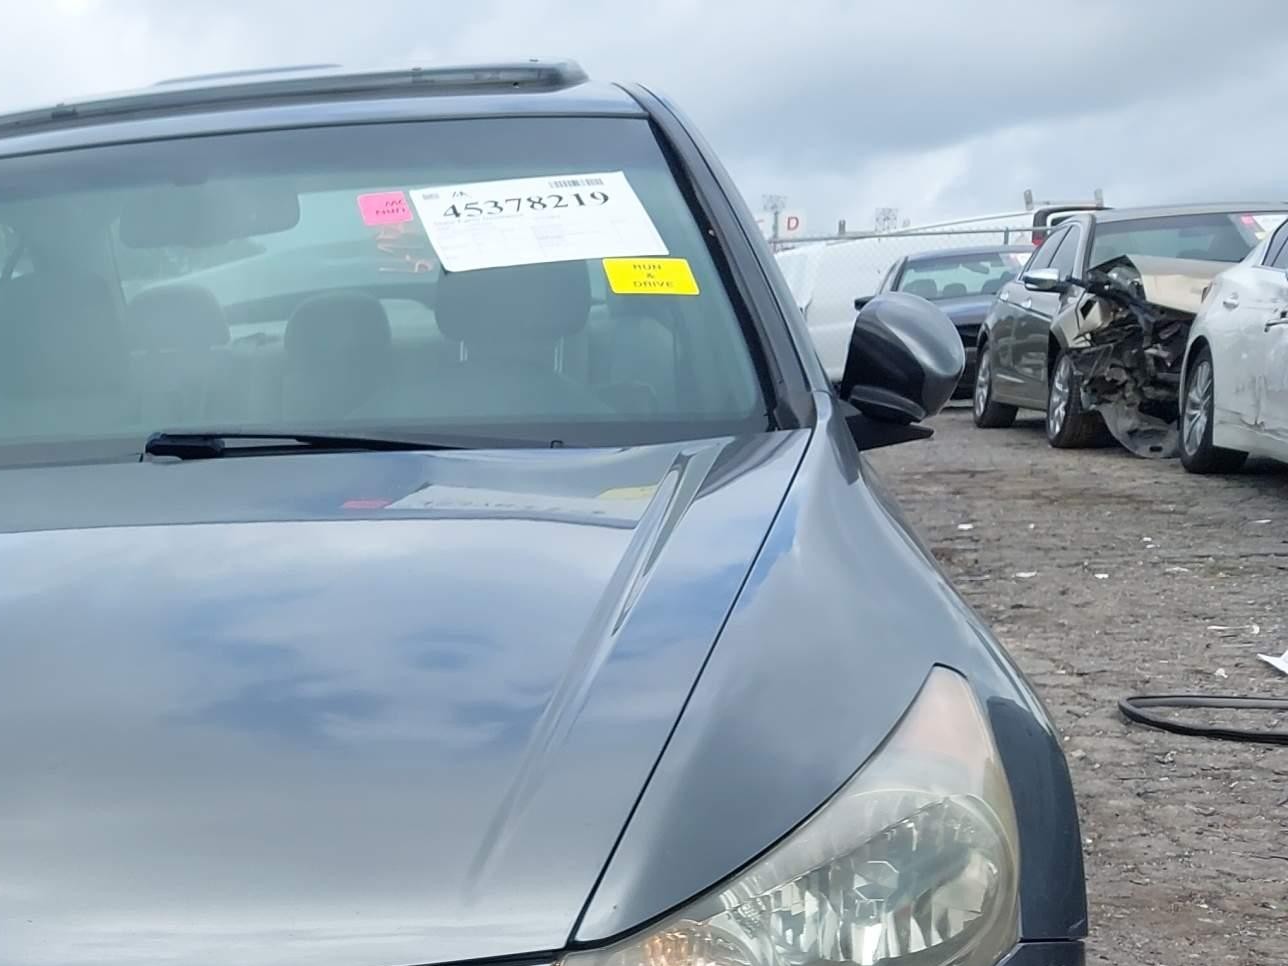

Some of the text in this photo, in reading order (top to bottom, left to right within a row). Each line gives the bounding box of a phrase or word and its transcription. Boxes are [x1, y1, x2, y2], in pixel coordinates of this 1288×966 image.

[443, 191, 610, 218] 45378219
[787, 216, 799, 231] D
[632, 263, 662, 271] RUN
[632, 280, 674, 288] DRIVE
